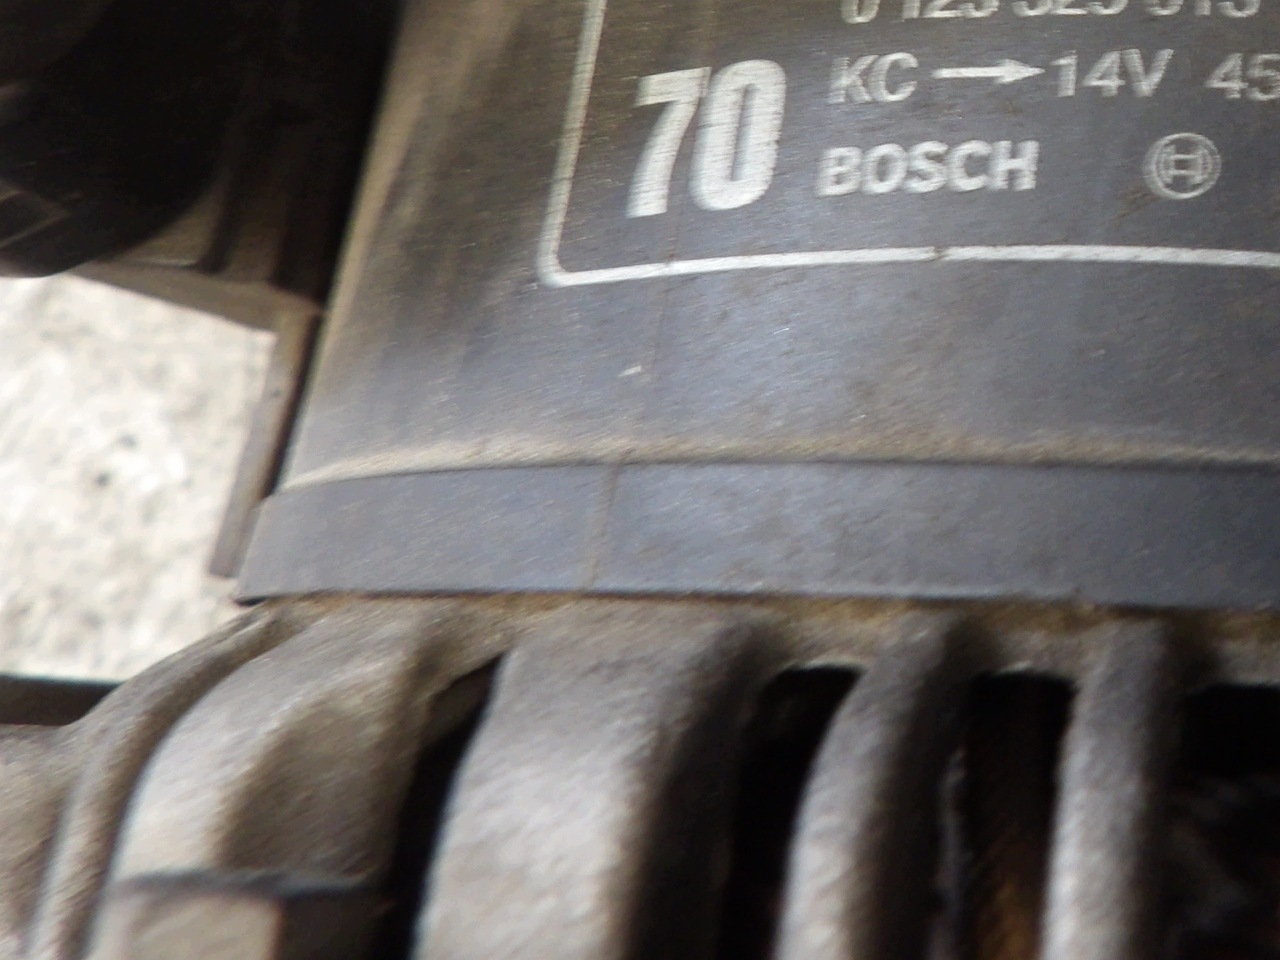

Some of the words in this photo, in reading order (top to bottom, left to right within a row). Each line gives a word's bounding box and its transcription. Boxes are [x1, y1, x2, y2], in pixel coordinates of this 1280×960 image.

[826, 52, 920, 104] KC
[1050, 48, 1175, 98] 14V
[625, 58, 787, 219] 70
[816, 139, 1041, 198] BOSCH
